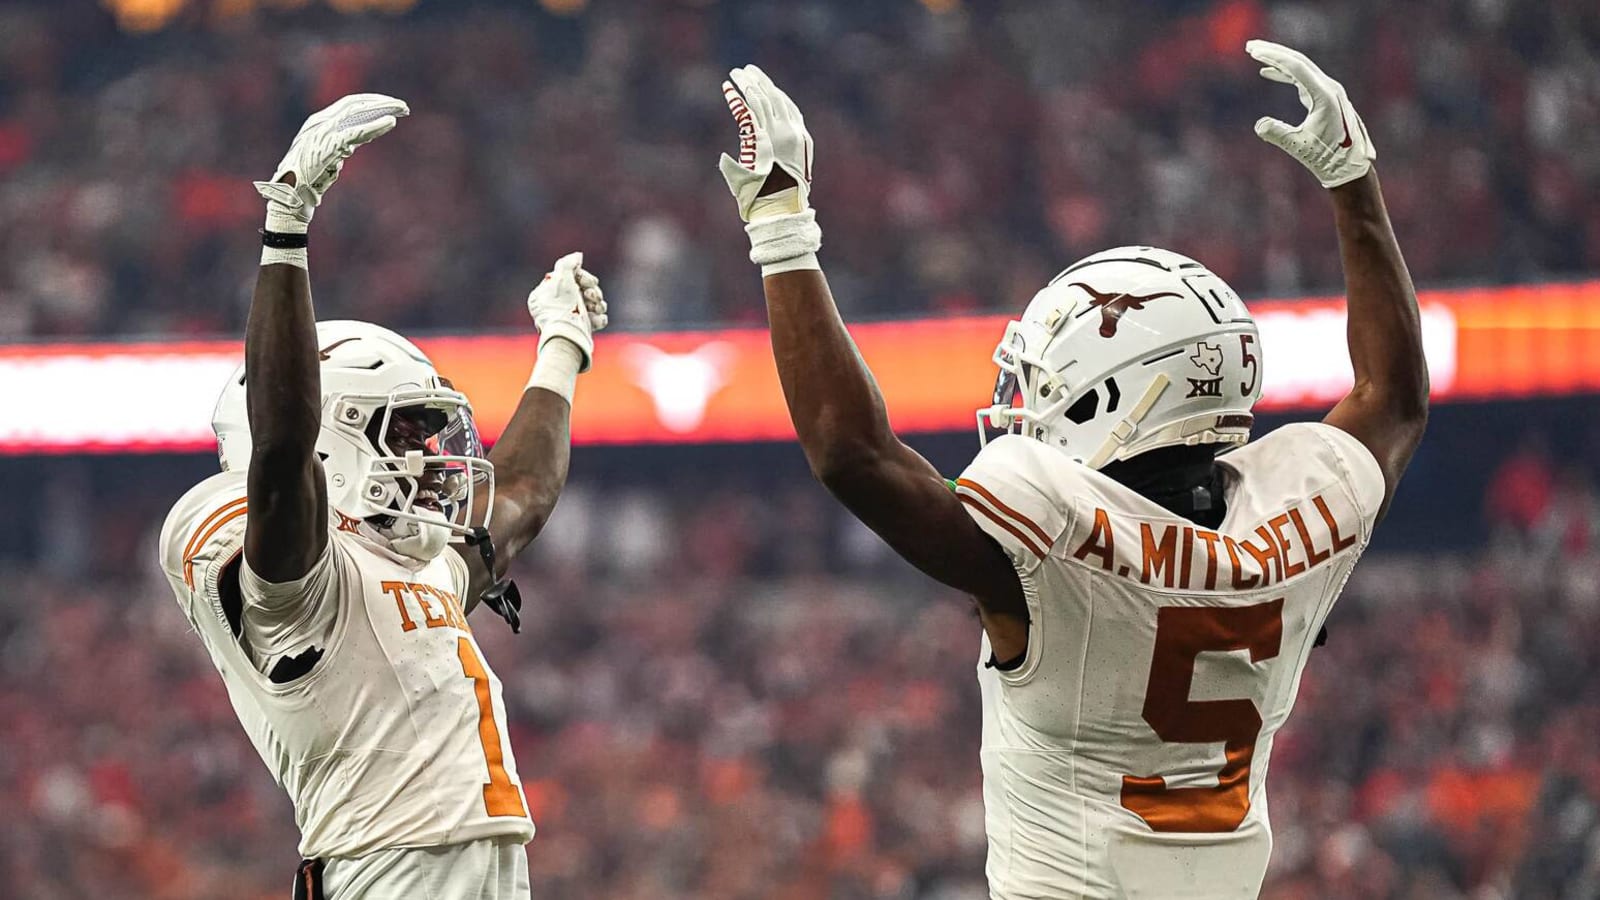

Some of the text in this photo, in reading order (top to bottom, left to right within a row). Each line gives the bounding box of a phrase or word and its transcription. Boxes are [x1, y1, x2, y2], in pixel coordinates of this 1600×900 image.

[1185, 375, 1225, 399] XII
[1240, 334, 1257, 397] 5
[1073, 494, 1357, 591] A.MITCHELL
[457, 636, 528, 818] 1
[1120, 597, 1285, 833] 5
